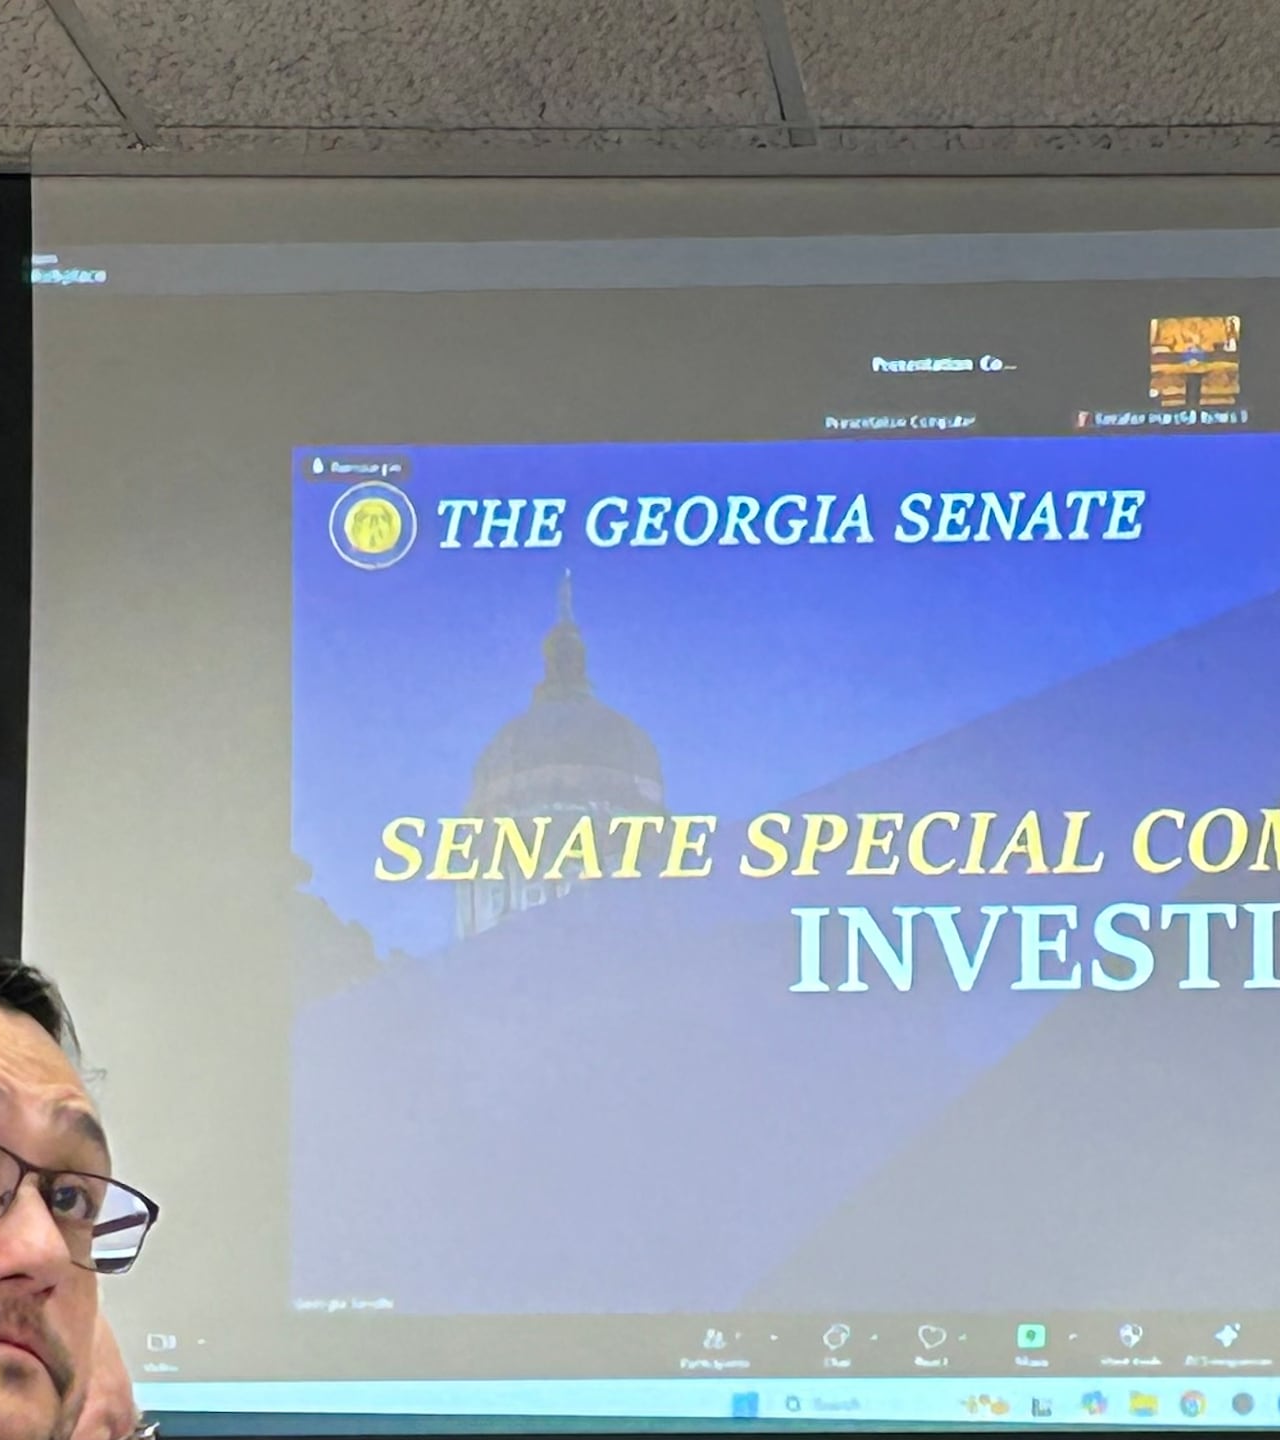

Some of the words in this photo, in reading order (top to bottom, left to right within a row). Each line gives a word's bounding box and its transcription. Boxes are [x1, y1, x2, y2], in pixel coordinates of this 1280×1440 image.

[437, 498, 567, 549] THE
[585, 493, 875, 548] GEORGIA
[894, 489, 1146, 544] SENATE
[373, 815, 718, 882] SENATE
[738, 810, 1106, 877] SPECIAL
